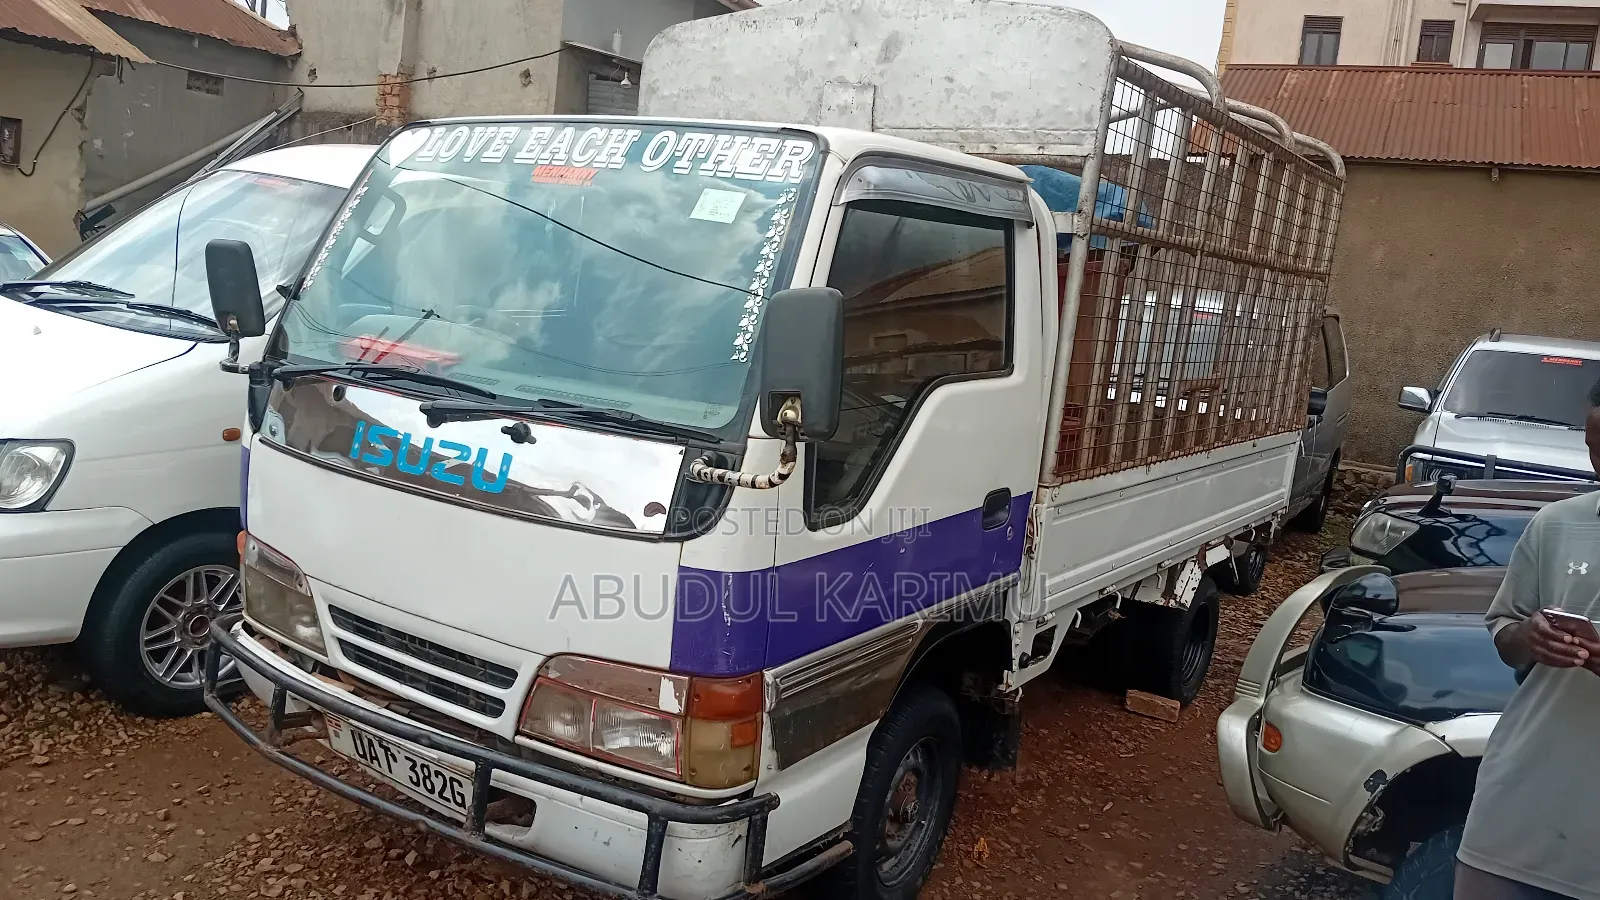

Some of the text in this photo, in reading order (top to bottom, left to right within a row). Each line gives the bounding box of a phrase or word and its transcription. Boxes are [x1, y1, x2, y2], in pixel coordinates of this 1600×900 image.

[415, 126, 815, 183] LOVE EACH OTHER
[349, 420, 513, 494] ISUZU
[405, 756, 467, 810] 382G
